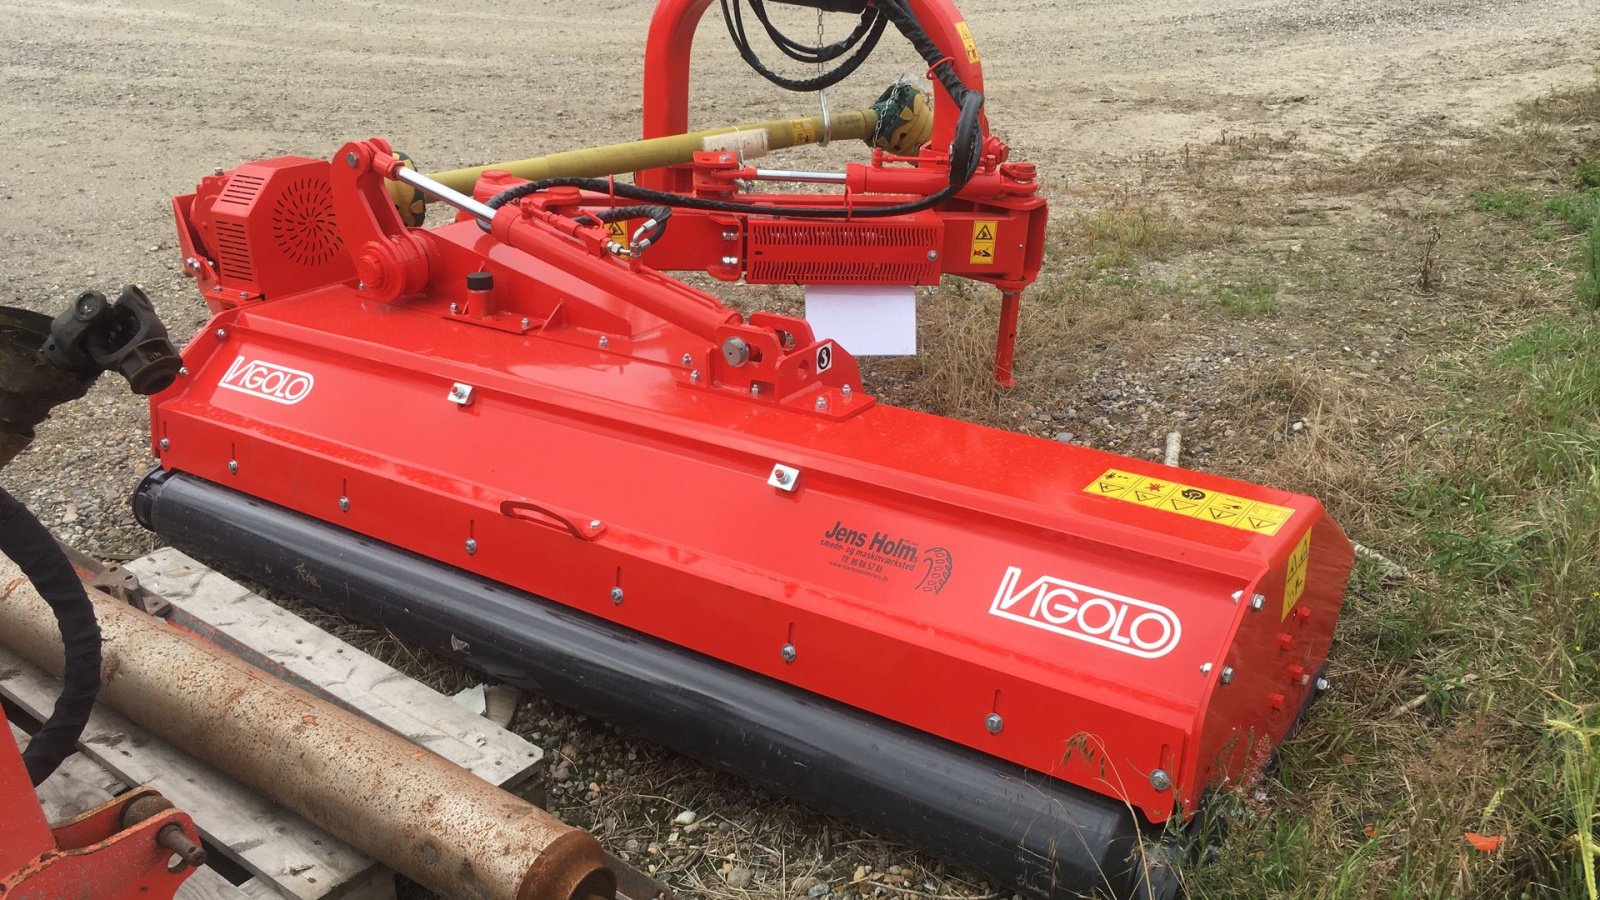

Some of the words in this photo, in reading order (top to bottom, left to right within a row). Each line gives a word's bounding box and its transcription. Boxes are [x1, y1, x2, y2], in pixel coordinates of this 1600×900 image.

[218, 355, 314, 404] VIGOLO
[825, 520, 868, 547] Jens
[845, 547, 855, 556] og
[856, 550, 916, 572] maskinværksted
[989, 566, 1181, 658] VIGOLO
